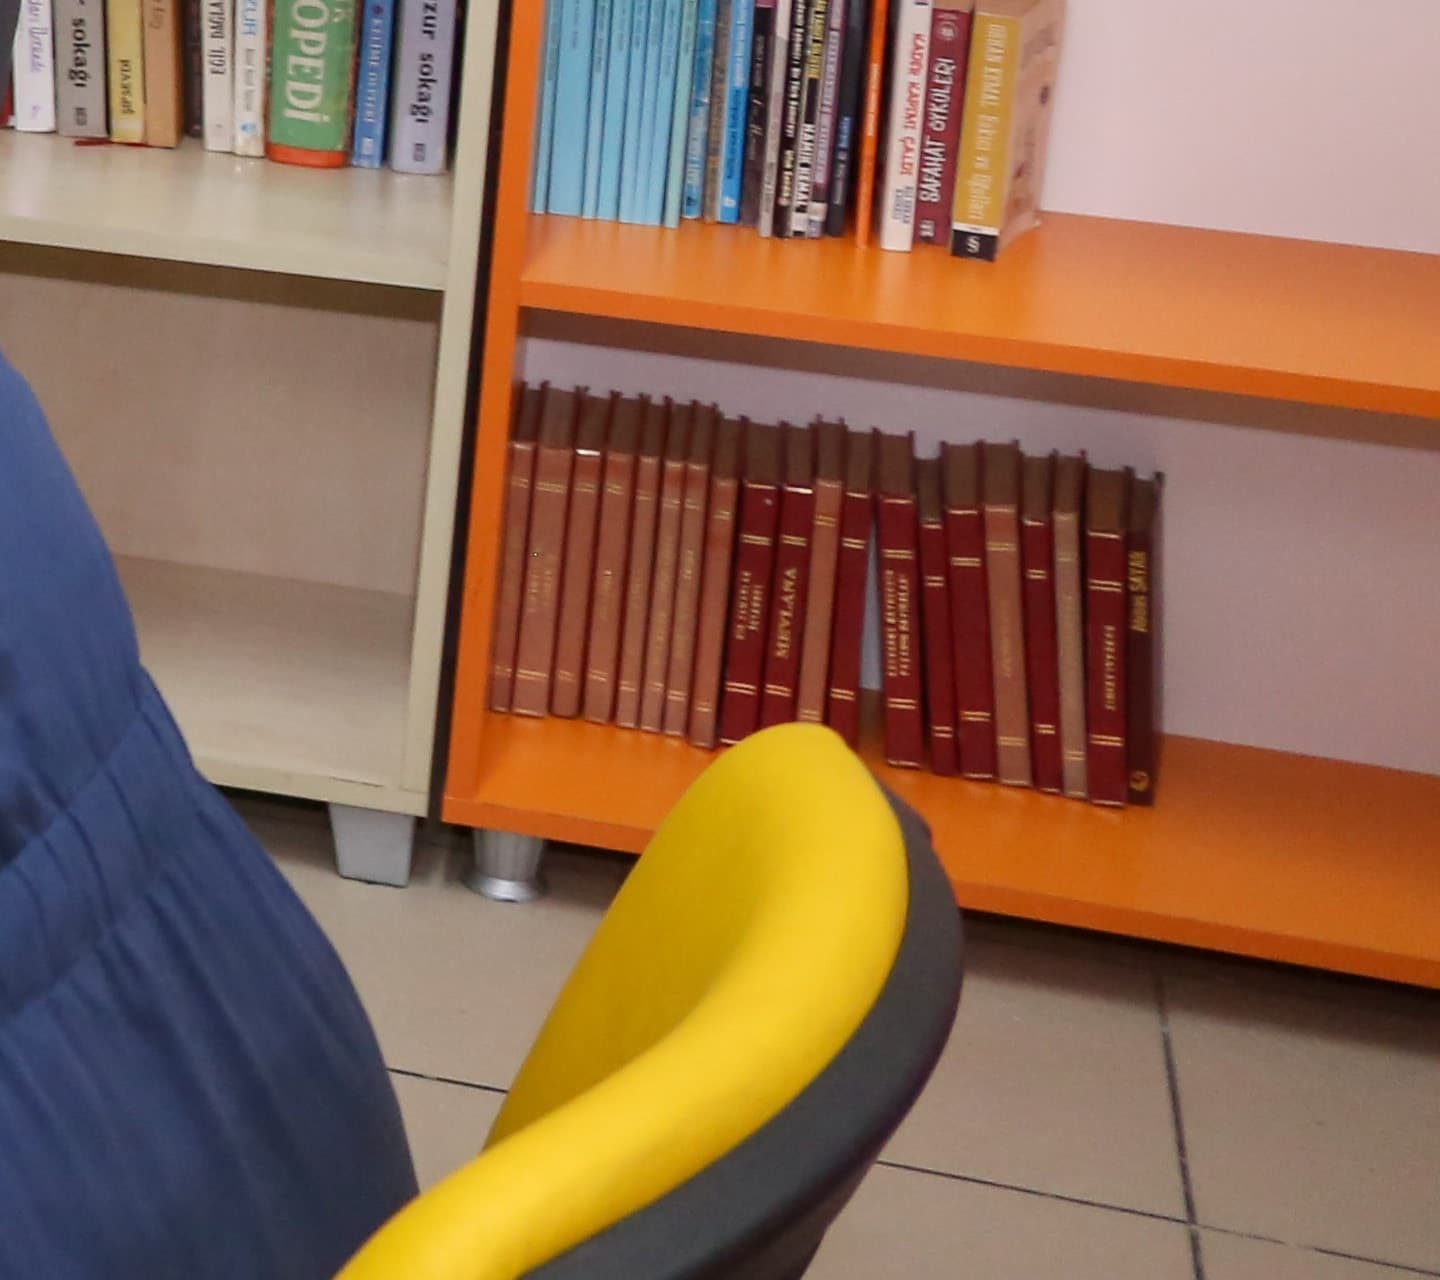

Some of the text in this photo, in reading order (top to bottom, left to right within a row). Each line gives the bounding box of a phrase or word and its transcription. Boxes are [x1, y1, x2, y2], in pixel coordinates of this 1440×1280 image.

[67, 18, 91, 87] sokağı
[410, 53, 437, 124] sokağı
[898, 33, 929, 176] KADER KAPIMI ÇALDI
[775, 568, 798, 659] MEVLANA
